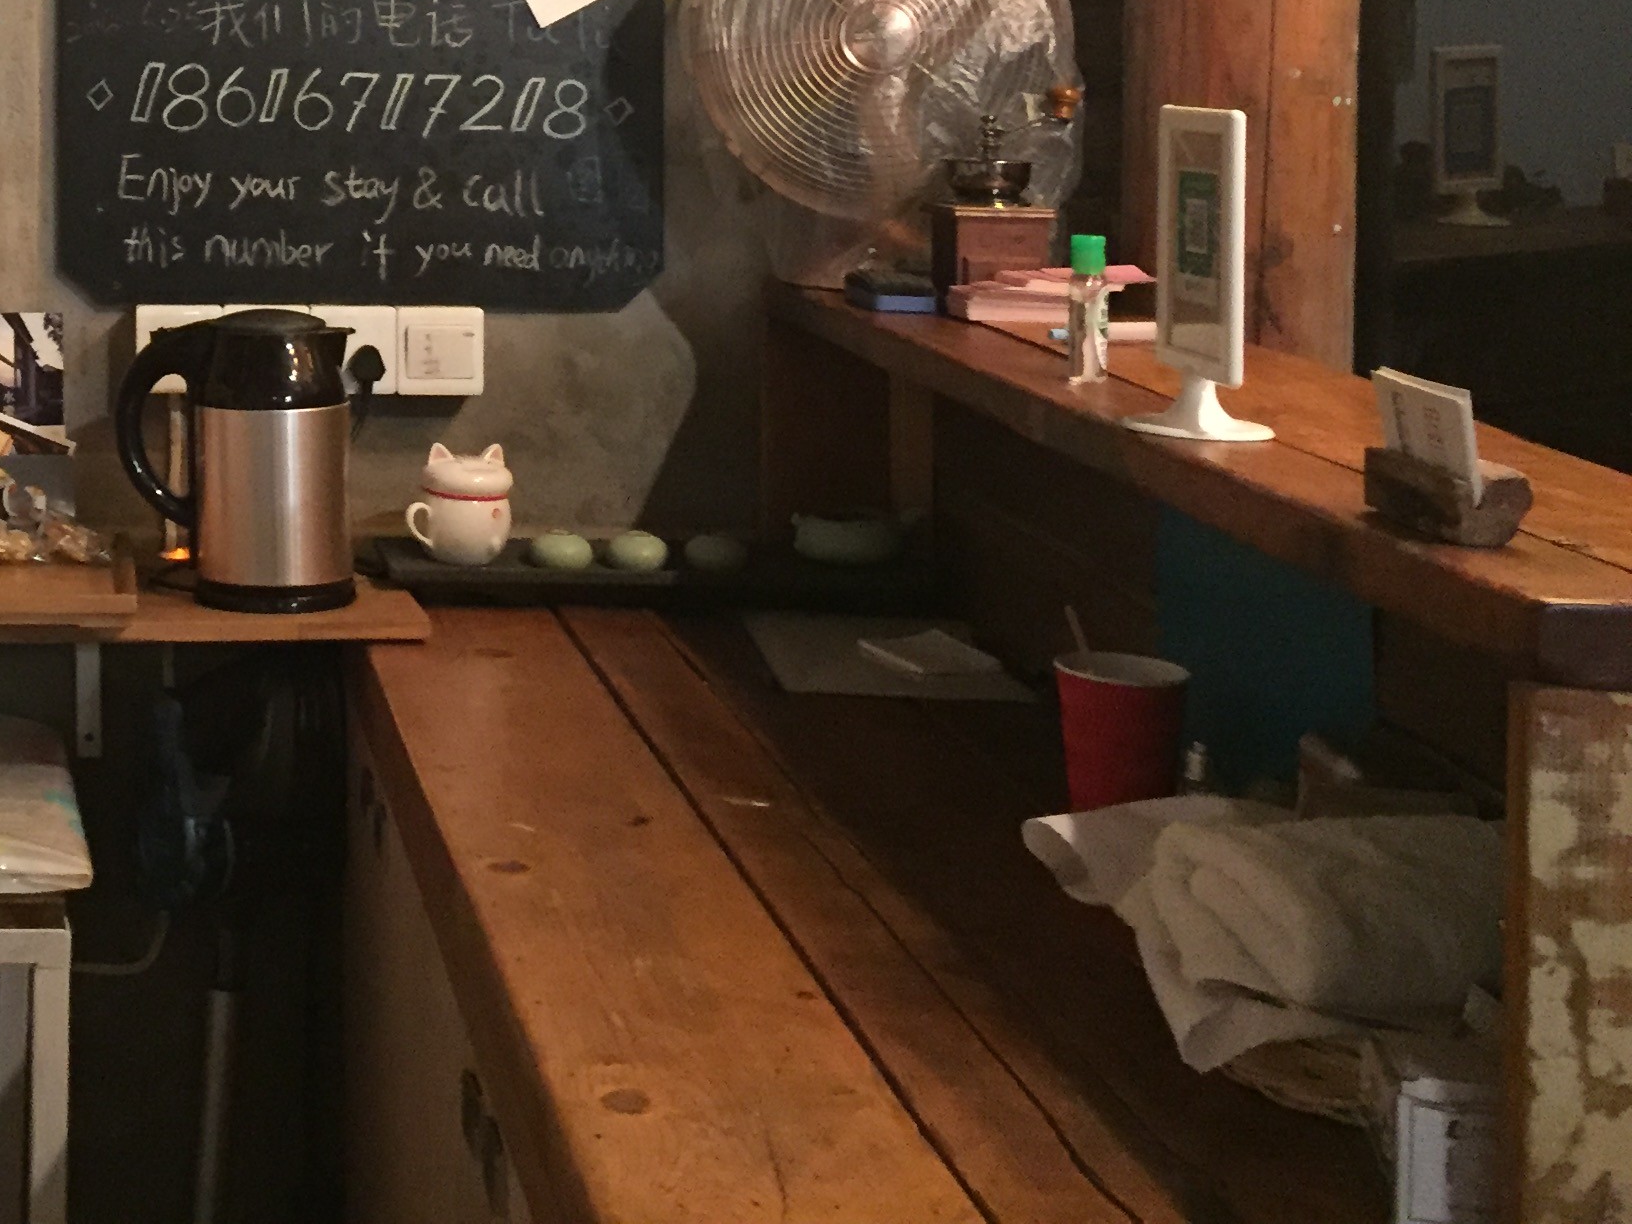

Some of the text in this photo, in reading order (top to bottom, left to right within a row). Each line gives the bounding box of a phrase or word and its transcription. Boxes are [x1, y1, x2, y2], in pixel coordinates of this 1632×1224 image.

[130, 61, 587, 139] 18616717218
[117, 153, 212, 216] Enjoy
[229, 175, 300, 210] your
[413, 167, 442, 210] &
[123, 226, 185, 269] this
[205, 229, 334, 268] number
[361, 230, 396, 280] if
[415, 240, 473, 275] you
[483, 234, 541, 272] need
